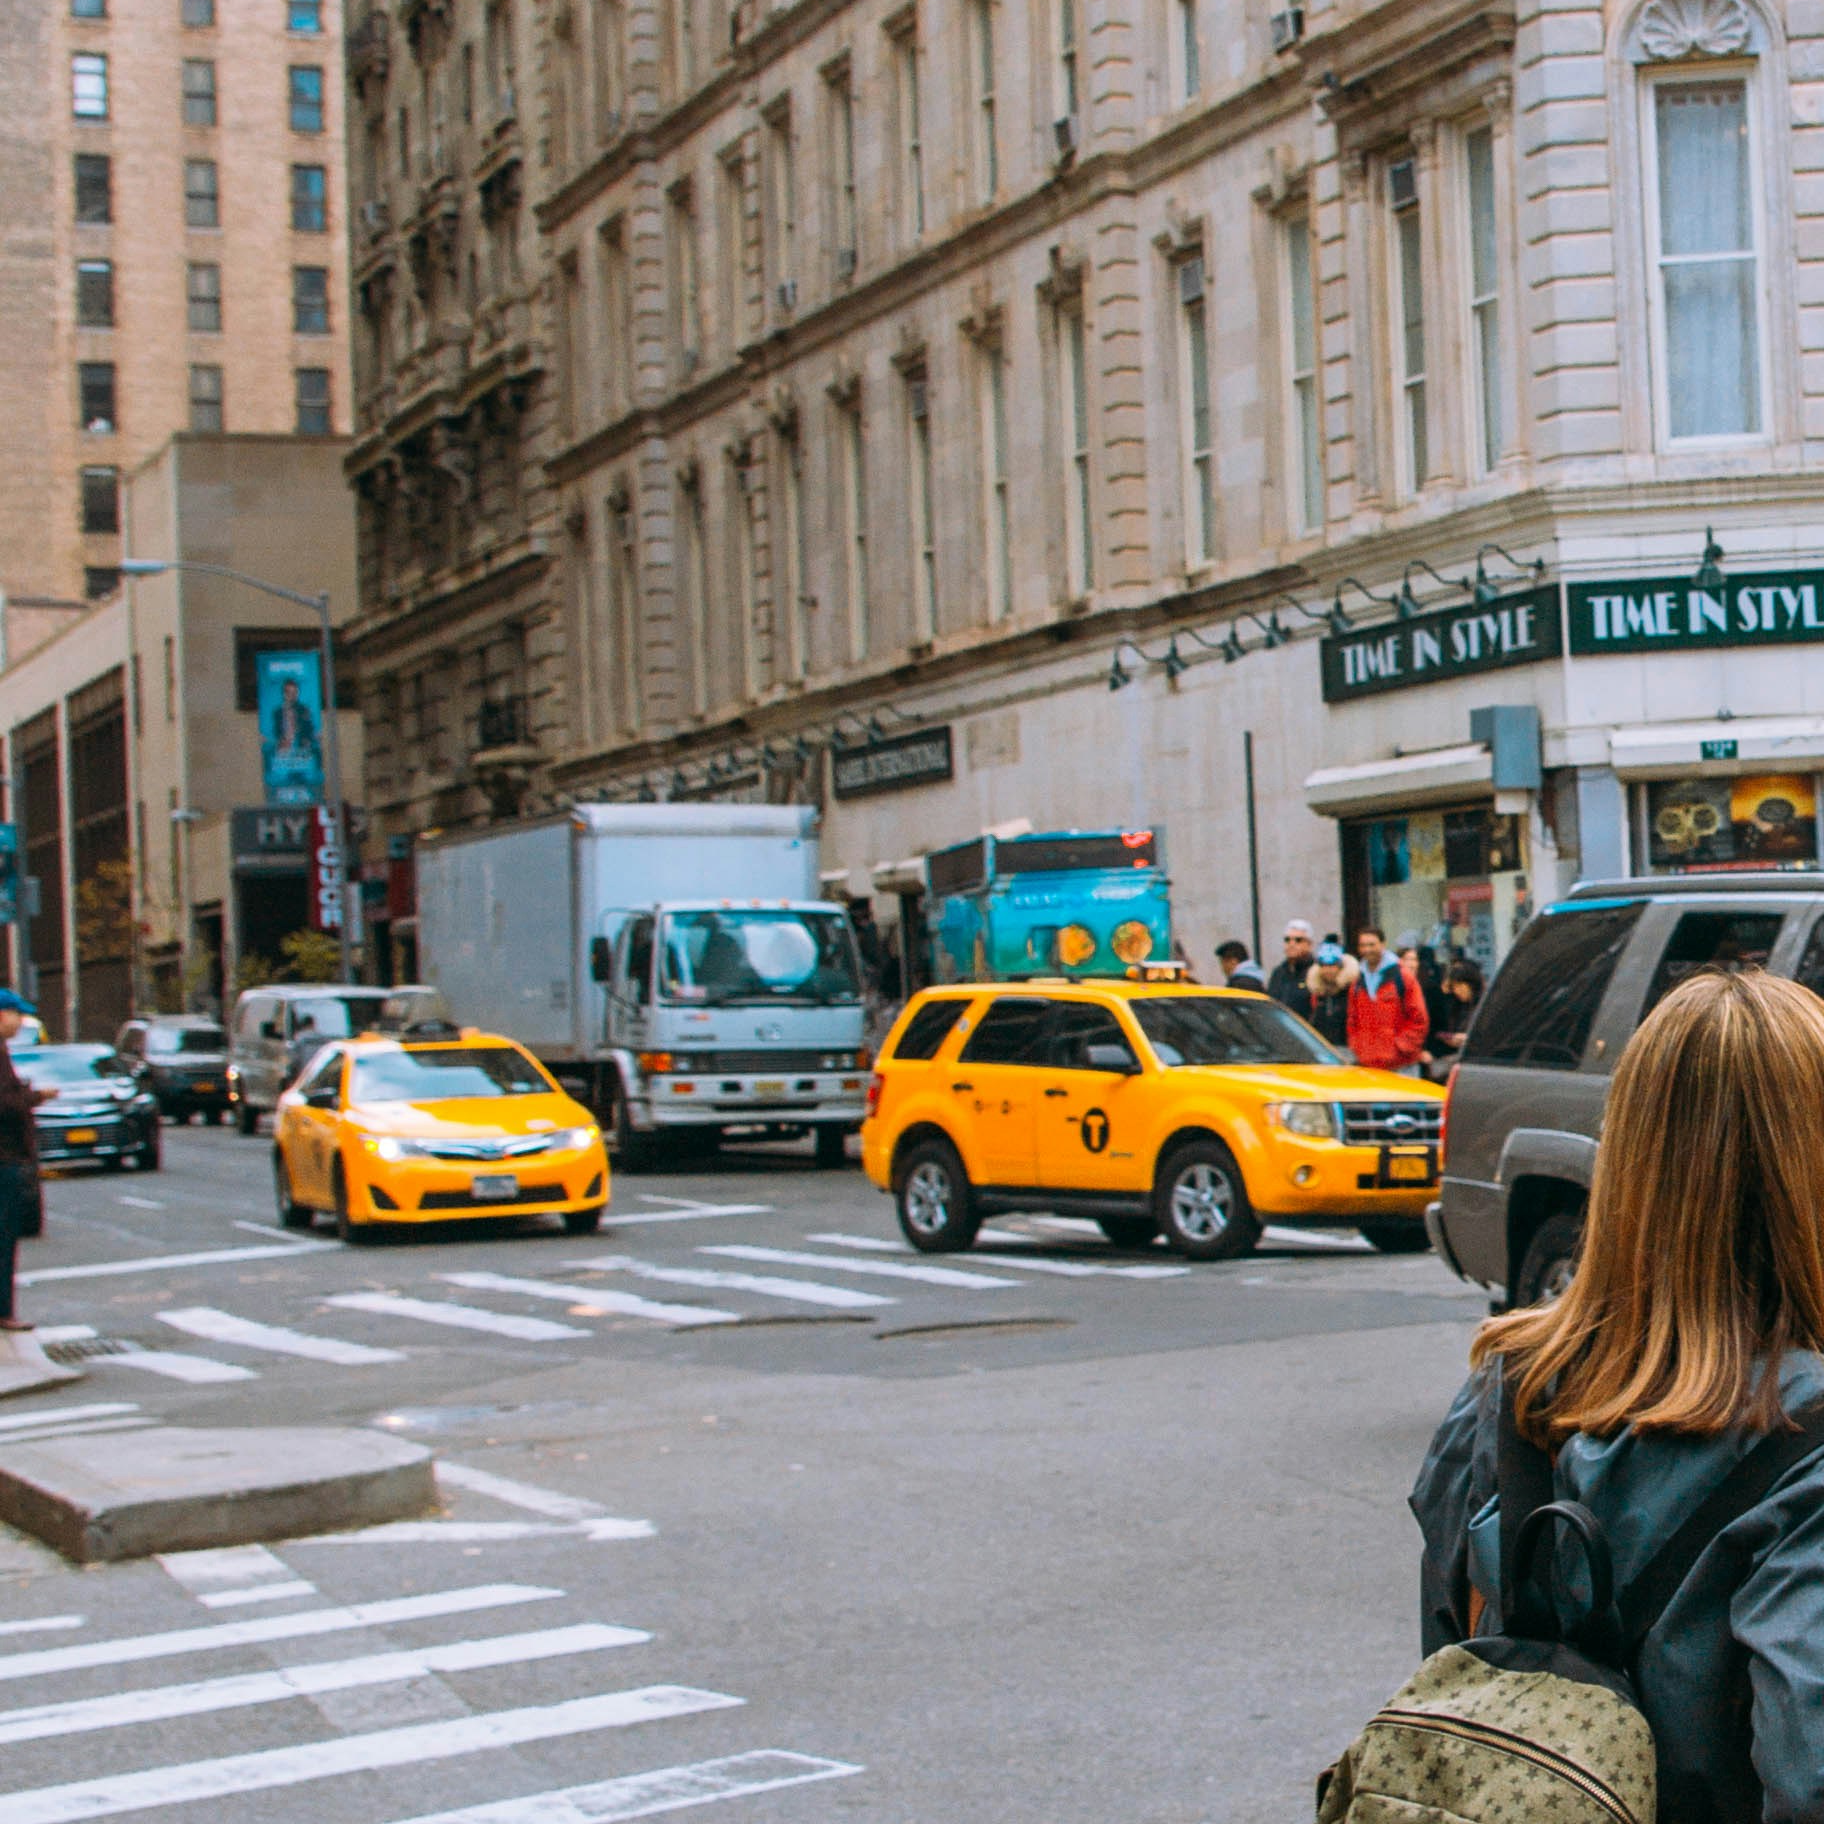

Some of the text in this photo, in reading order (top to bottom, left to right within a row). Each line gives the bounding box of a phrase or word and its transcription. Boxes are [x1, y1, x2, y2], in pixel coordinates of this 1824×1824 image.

[1341, 605, 1537, 685] TIME IN STYLE
[1587, 591, 1680, 640] TIME
[1687, 589, 1728, 635] IN
